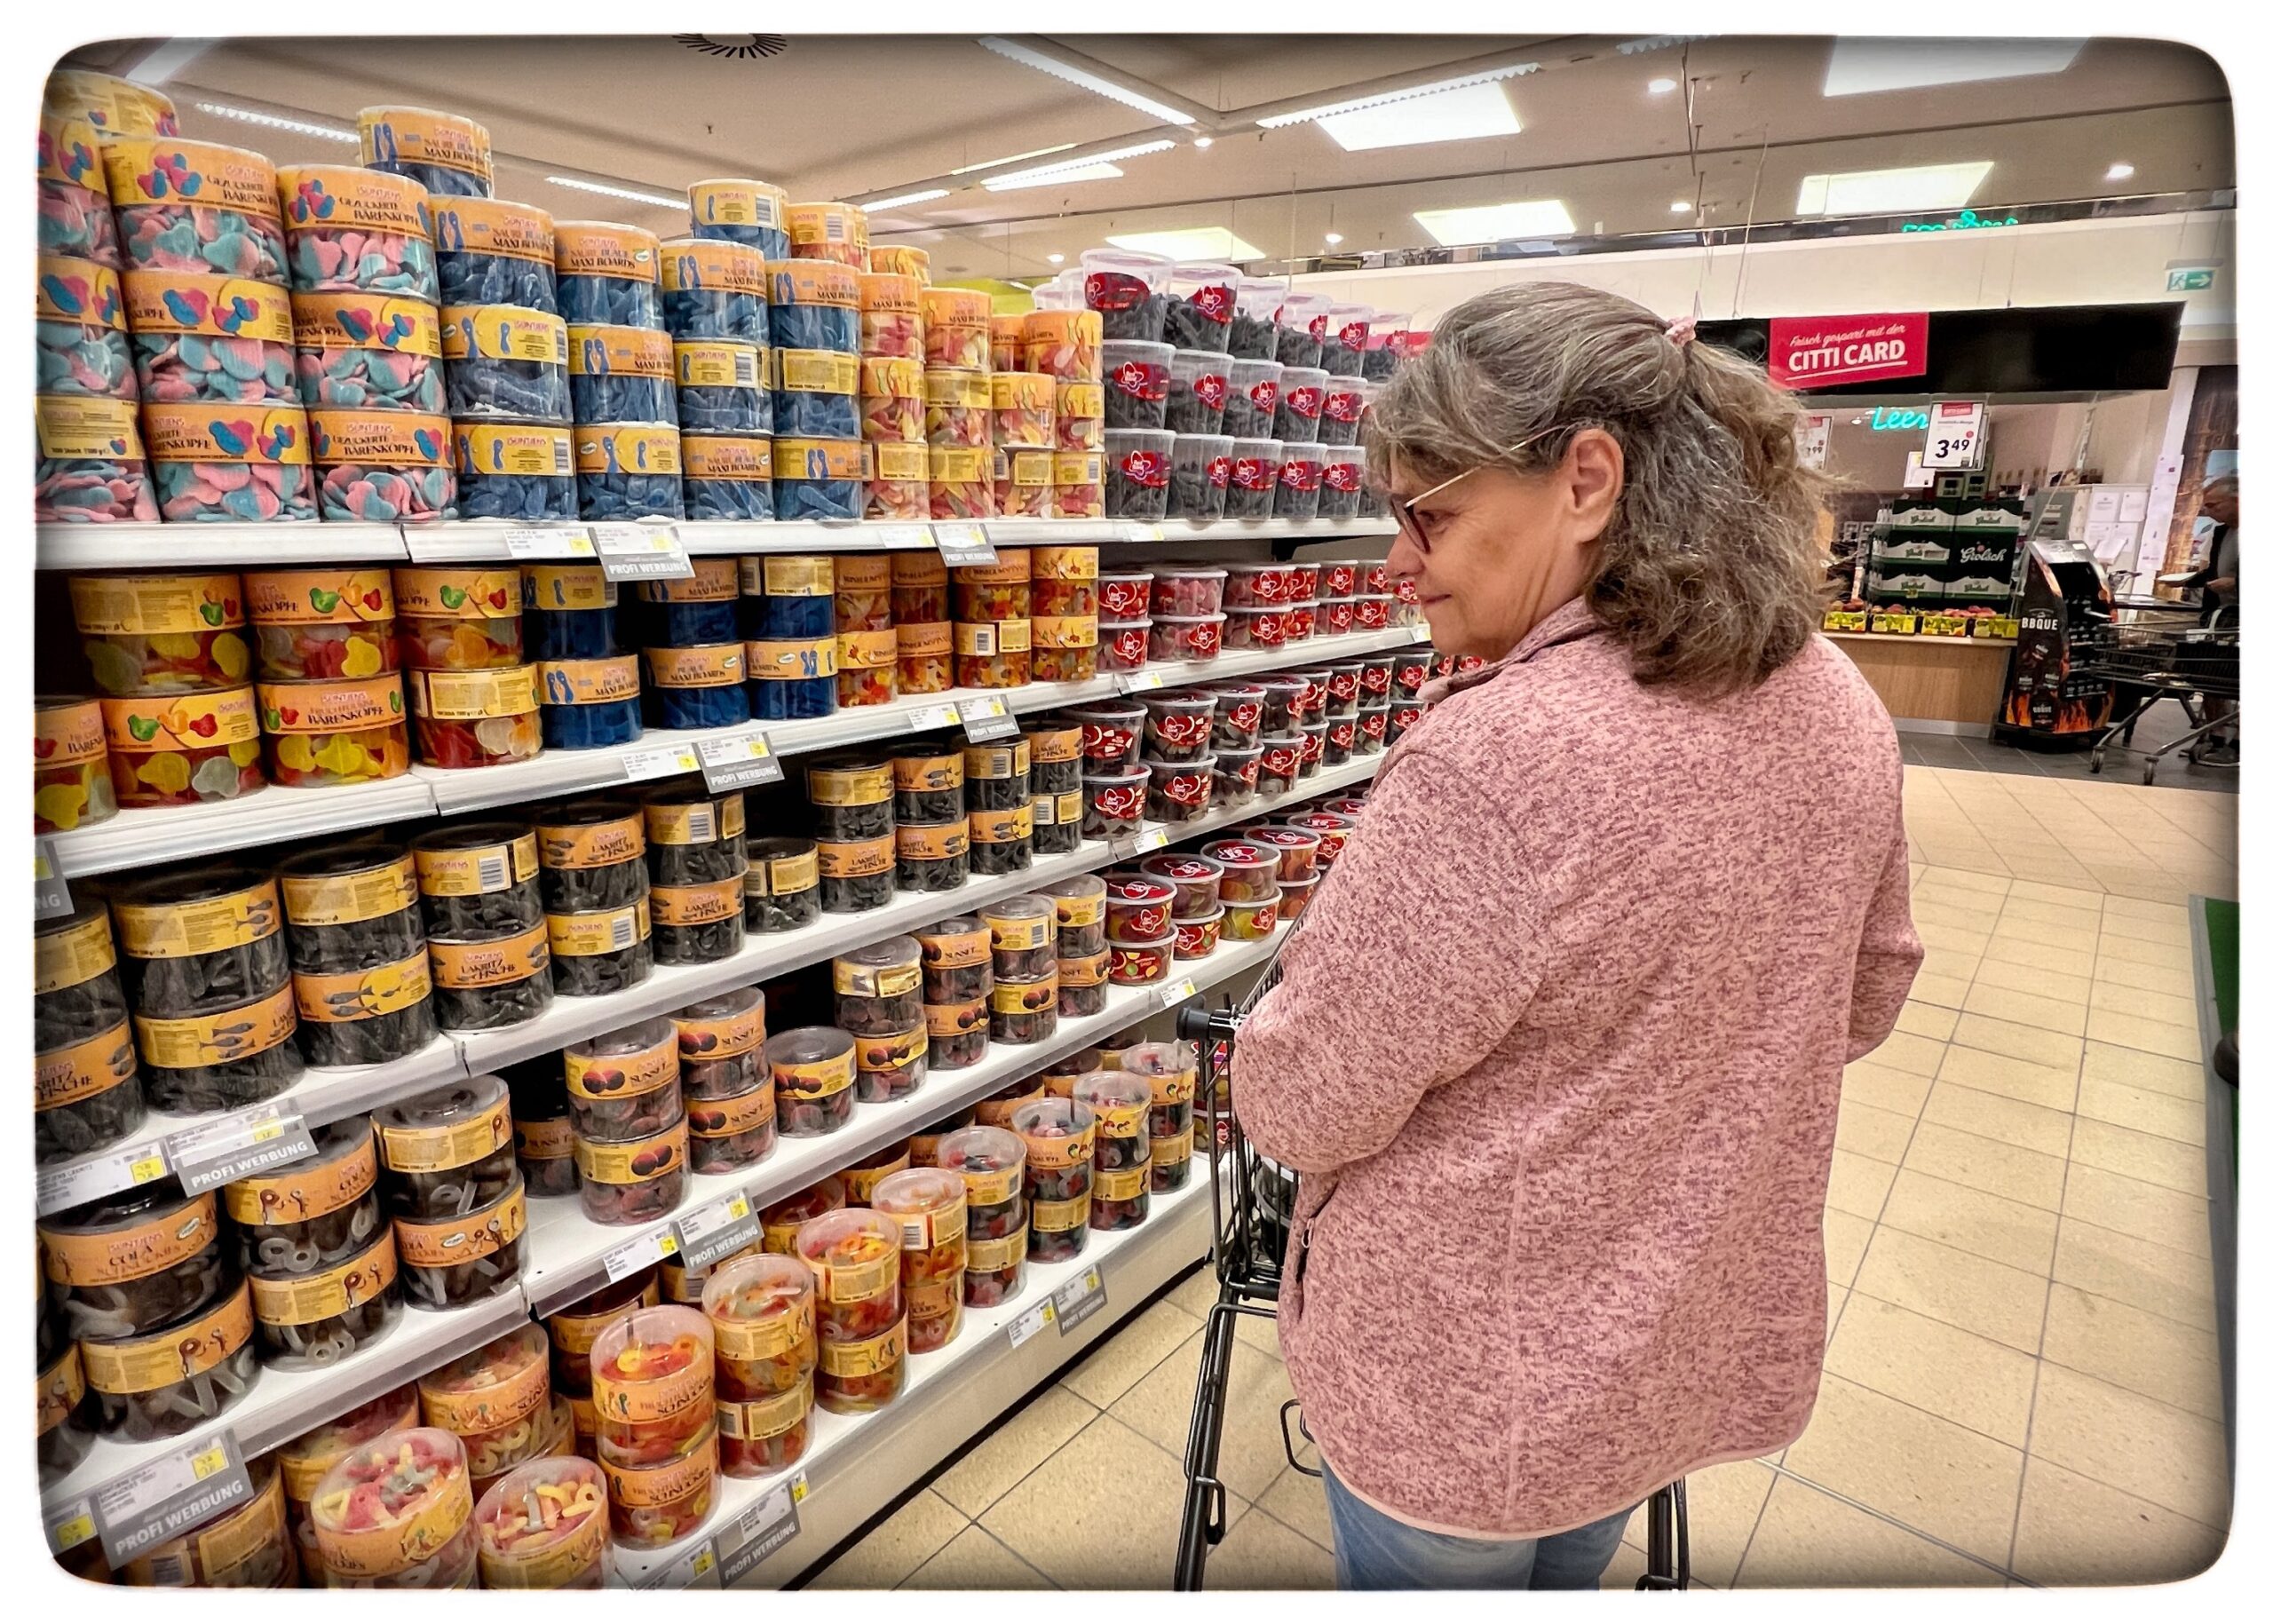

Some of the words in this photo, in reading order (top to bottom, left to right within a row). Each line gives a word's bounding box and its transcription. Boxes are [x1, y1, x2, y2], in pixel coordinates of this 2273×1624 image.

[571, 257, 594, 268] MAXI
[1789, 333, 1821, 347] Frisch
[1822, 329, 1864, 348] gespart
[1865, 325, 1885, 337] mit
[1886, 324, 1906, 335] der
[1788, 346, 1840, 372] CITTI
[1843, 339, 1906, 366] CARD
[1960, 544, 2008, 564] Grolsch
[608, 564, 638, 574] PROFI
[638, 561, 687, 574] WERBUNG
[2022, 617, 2059, 630] BBQUE
[710, 772, 736, 786] PROFI
[737, 765, 778, 782] WERBUNG
[461, 958, 503, 974] LAKRITZ
[190, 1166, 235, 1190] PROFI
[235, 1140, 309, 1176] WERBUNG
[689, 1246, 716, 1268] PROFI
[716, 1224, 758, 1254] WERBUNG
[115, 1521, 164, 1556] PROFI
[164, 1479, 244, 1528] WERBUNG
[725, 1555, 751, 1580] PROFI
[751, 1521, 796, 1561] WERBUNG
